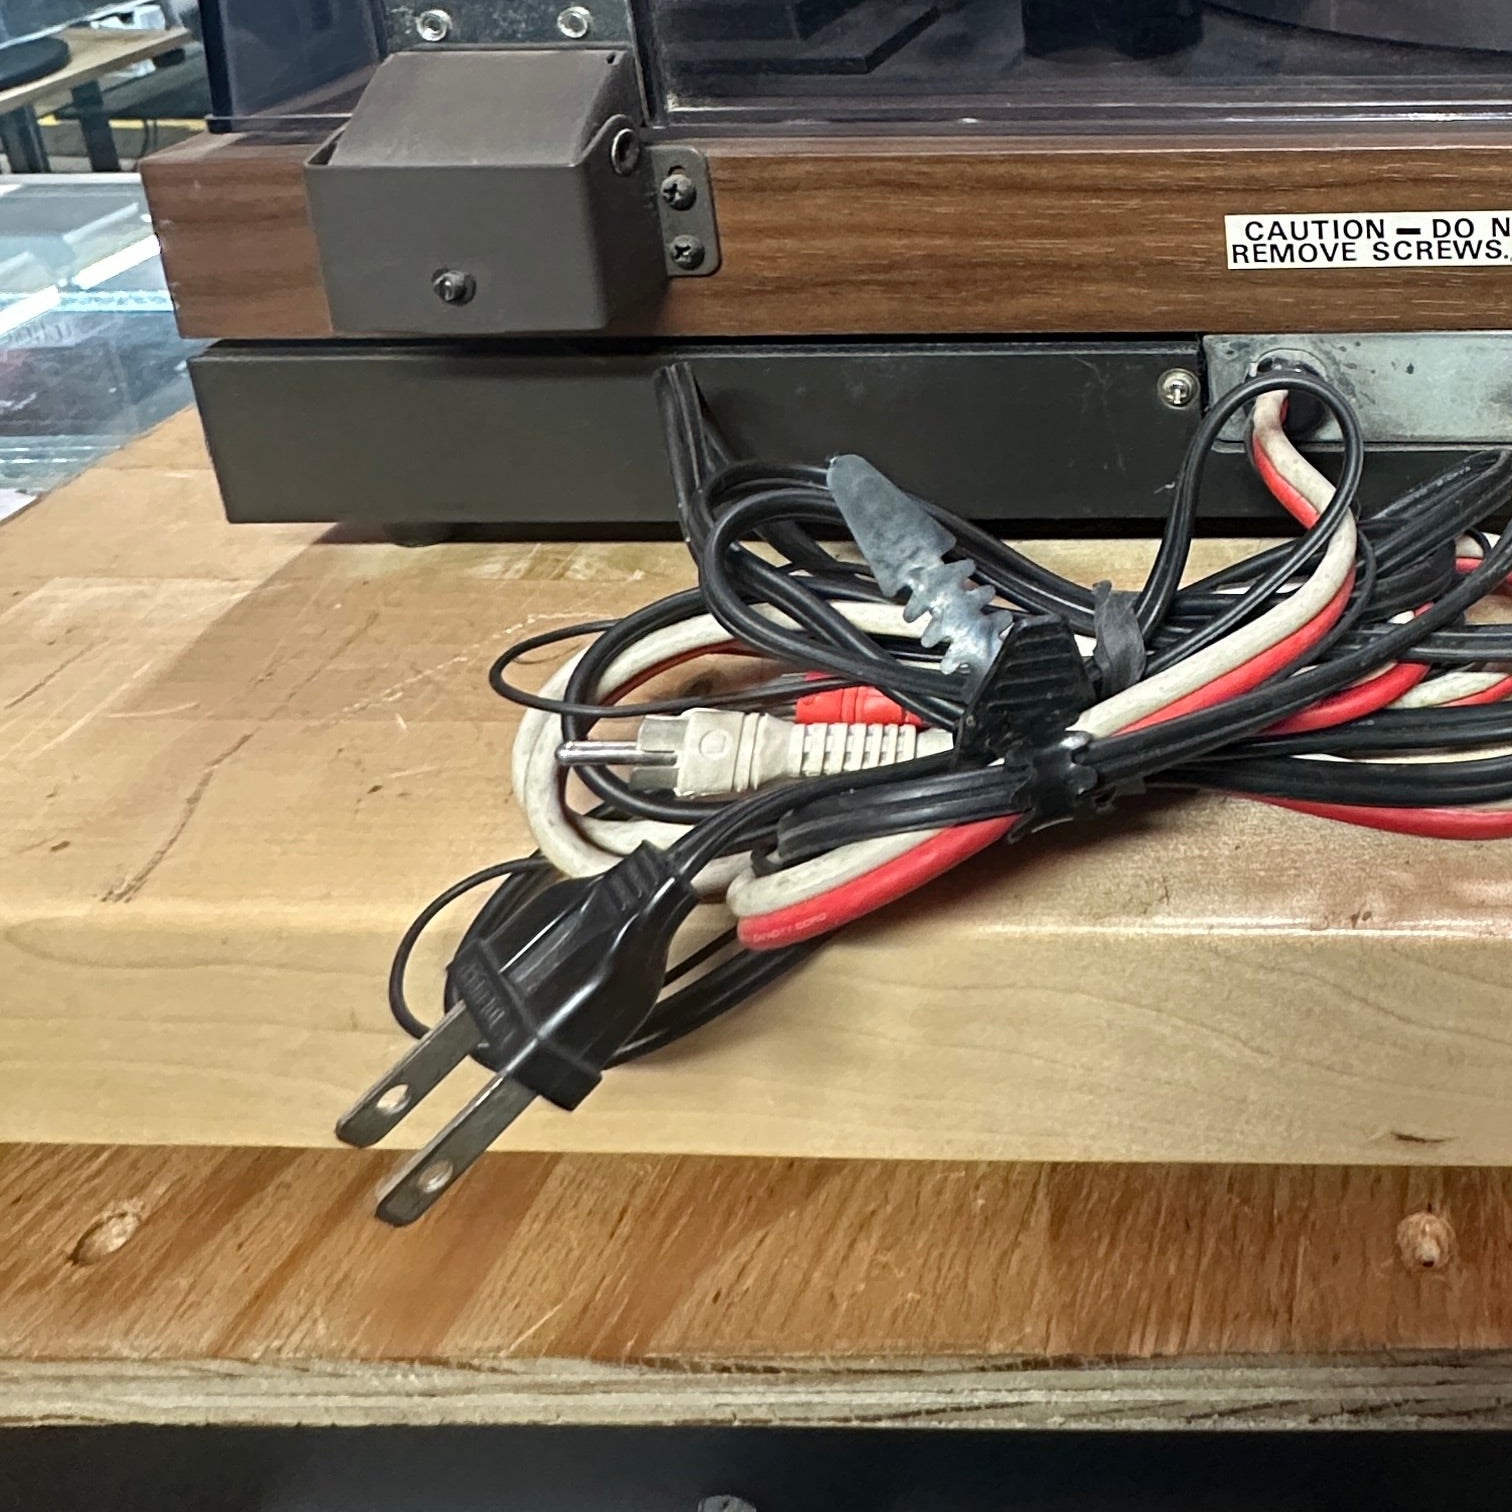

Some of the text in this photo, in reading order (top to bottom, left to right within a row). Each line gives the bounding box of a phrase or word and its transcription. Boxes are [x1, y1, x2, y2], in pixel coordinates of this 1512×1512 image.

[1245, 219, 1385, 241] CAUTION
[1432, 217, 1474, 239] DO
[1232, 239, 1509, 263] REMOVE SCREWS.
